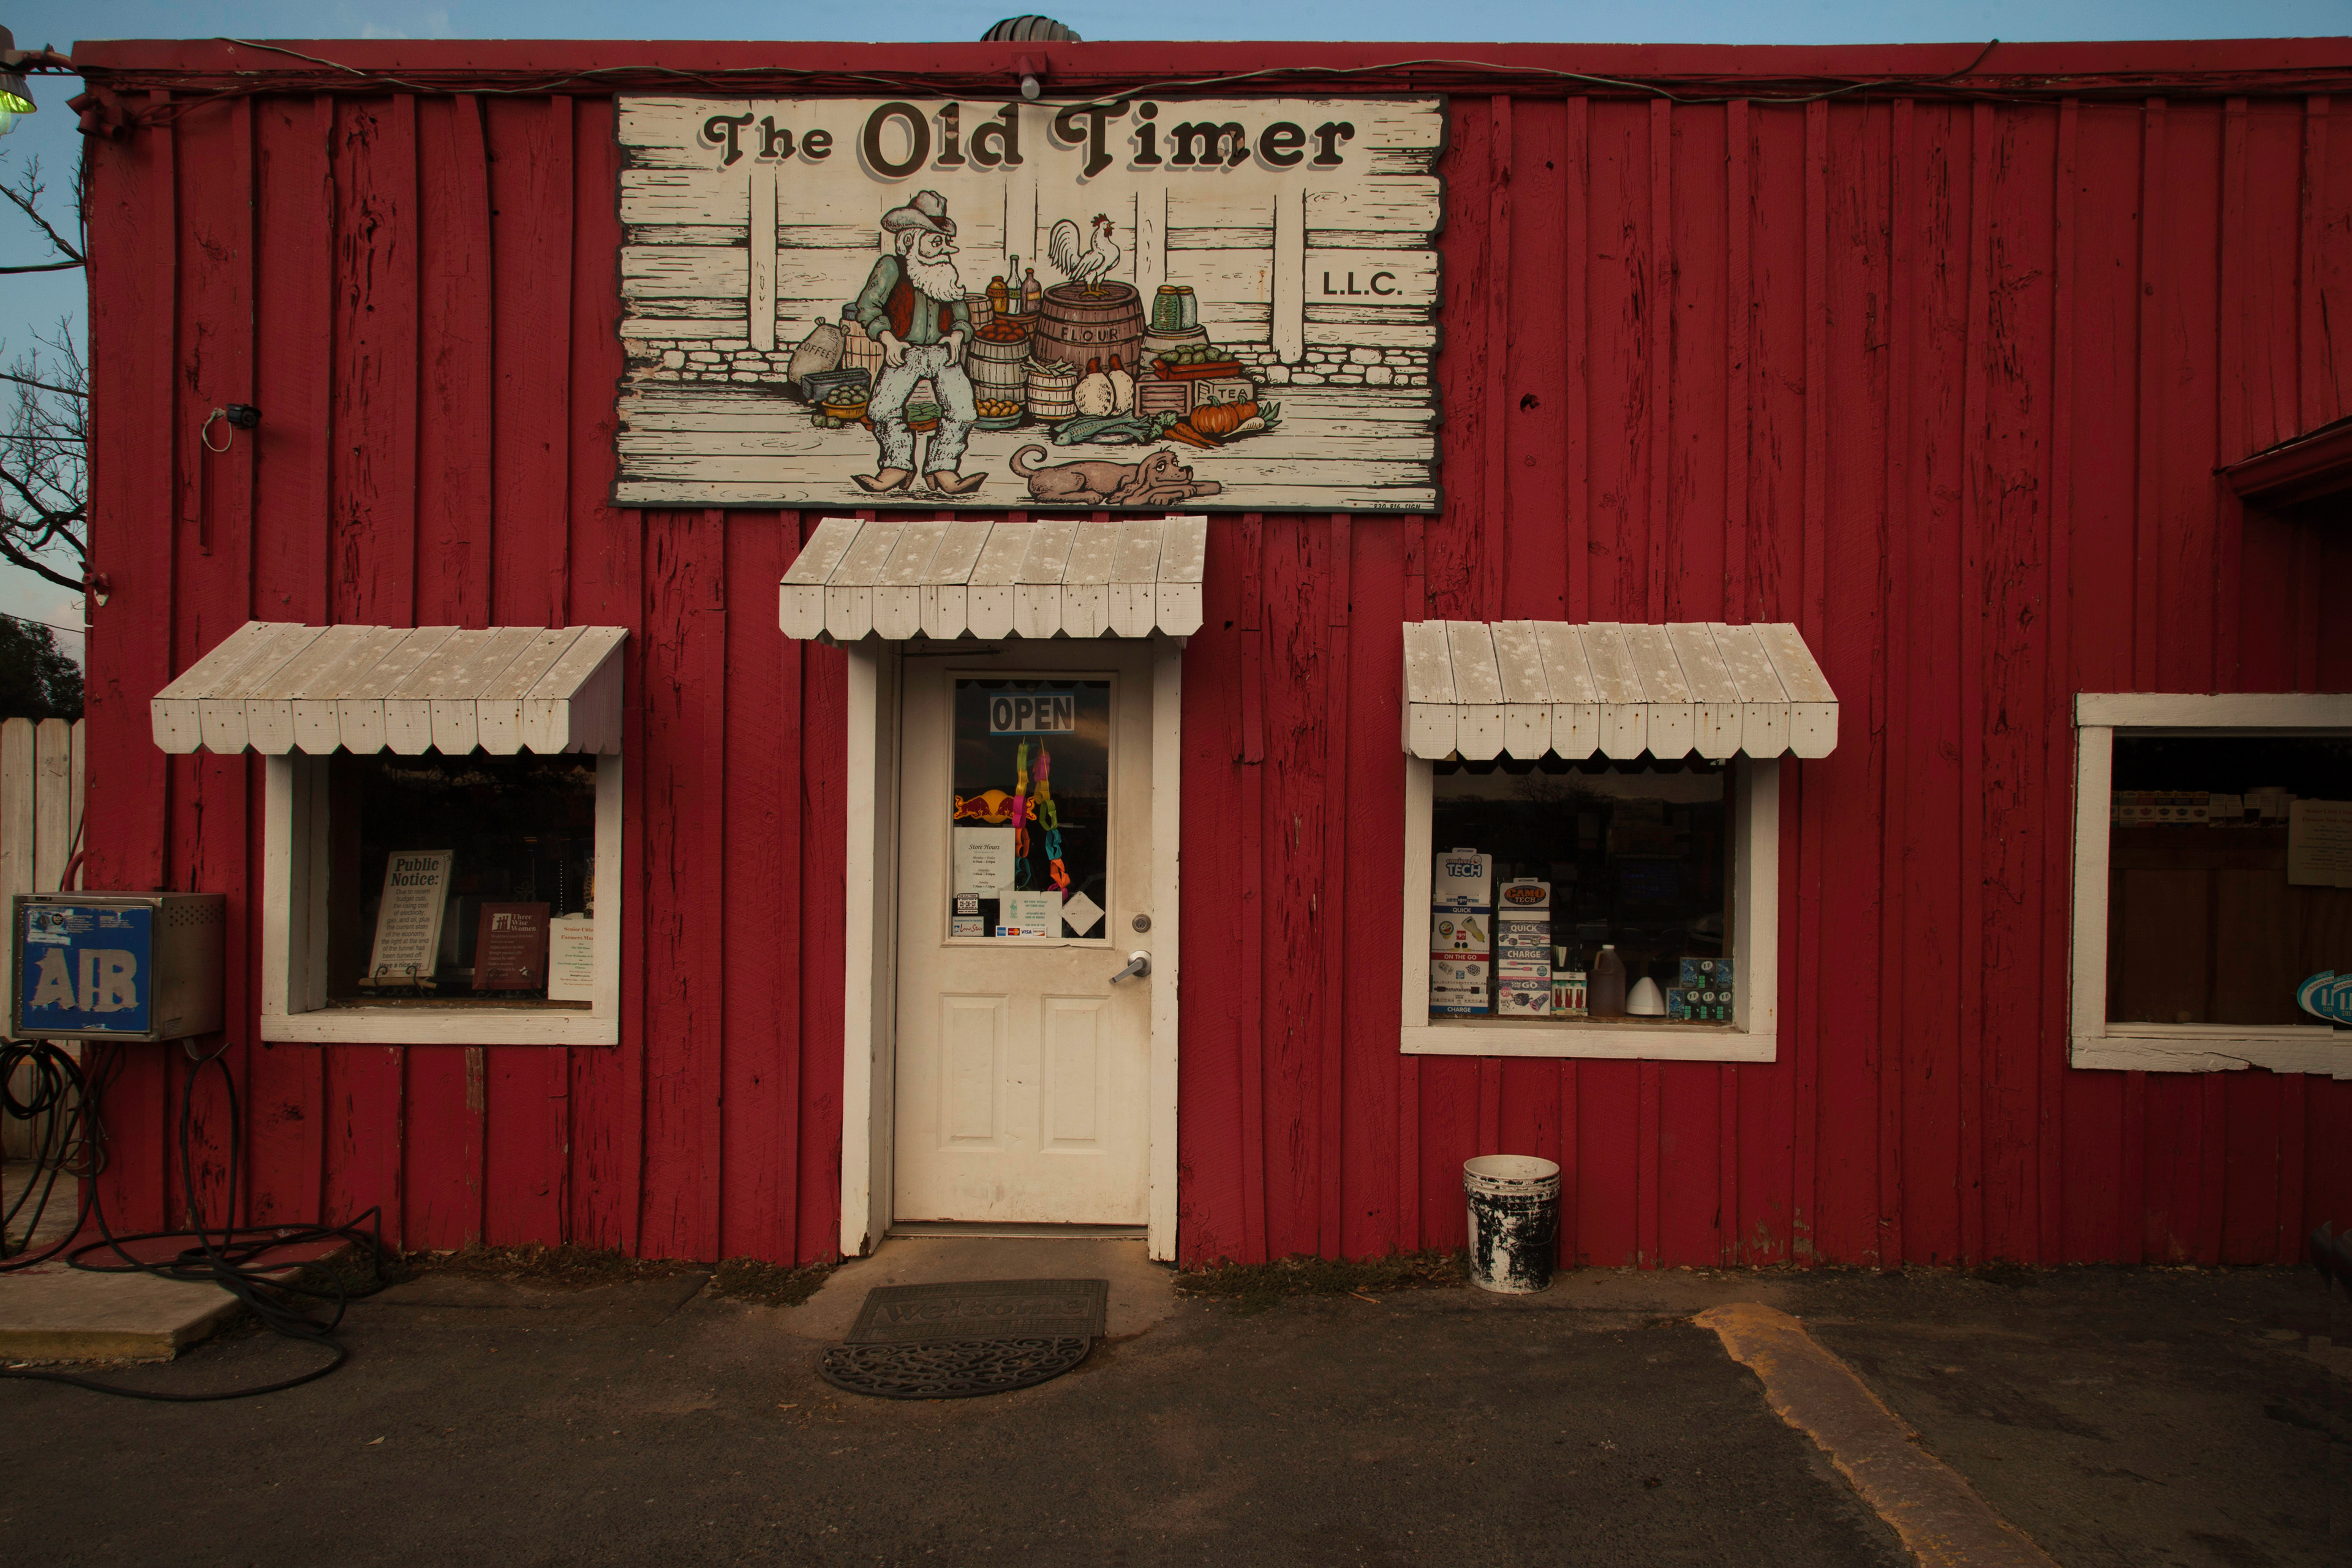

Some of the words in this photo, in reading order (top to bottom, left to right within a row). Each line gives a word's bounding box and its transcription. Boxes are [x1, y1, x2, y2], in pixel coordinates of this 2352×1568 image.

[697, 113, 833, 173] The
[858, 102, 1024, 183] Old
[1048, 99, 1355, 184] Timer
[1323, 271, 1403, 296] L.L.C.
[1061, 327, 1118, 342] FLOUR
[799, 341, 834, 360] COFFEE
[1217, 388, 1248, 399] TEA
[992, 697, 1072, 731] OPEN
[396, 858, 439, 872] Public
[1446, 864, 1482, 877] TECH
[390, 873, 439, 886] Notice:
[1506, 888, 1545, 898] CAMO
[29, 948, 141, 1012] AIR
